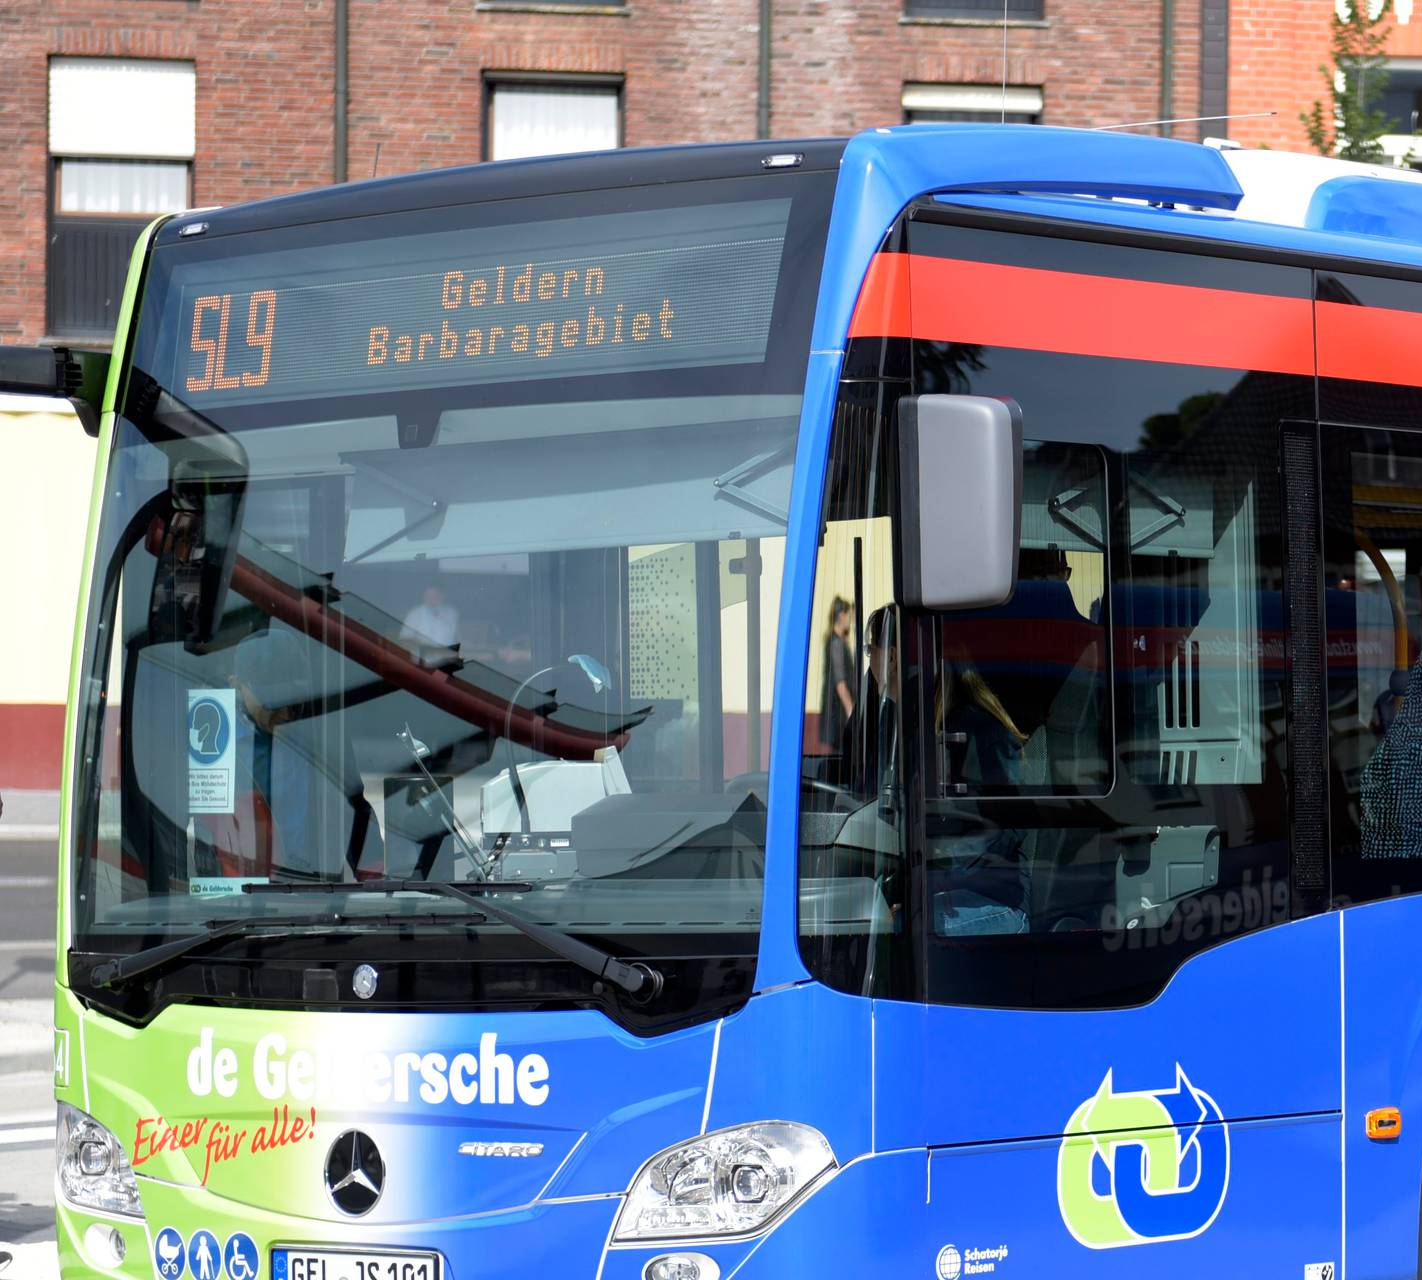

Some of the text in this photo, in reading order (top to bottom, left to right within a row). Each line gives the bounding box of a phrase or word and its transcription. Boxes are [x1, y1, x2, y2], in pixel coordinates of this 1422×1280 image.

[441, 262, 605, 310] Geldern
[185, 288, 277, 392] SL9
[367, 298, 674, 365] Barbaragebiet
[186, 1027, 550, 1106] de Geersche
[131, 1103, 316, 1187] Einer für alle!
[964, 1244, 1009, 1262] Schatorjé
[964, 1260, 994, 1275] Reisen
